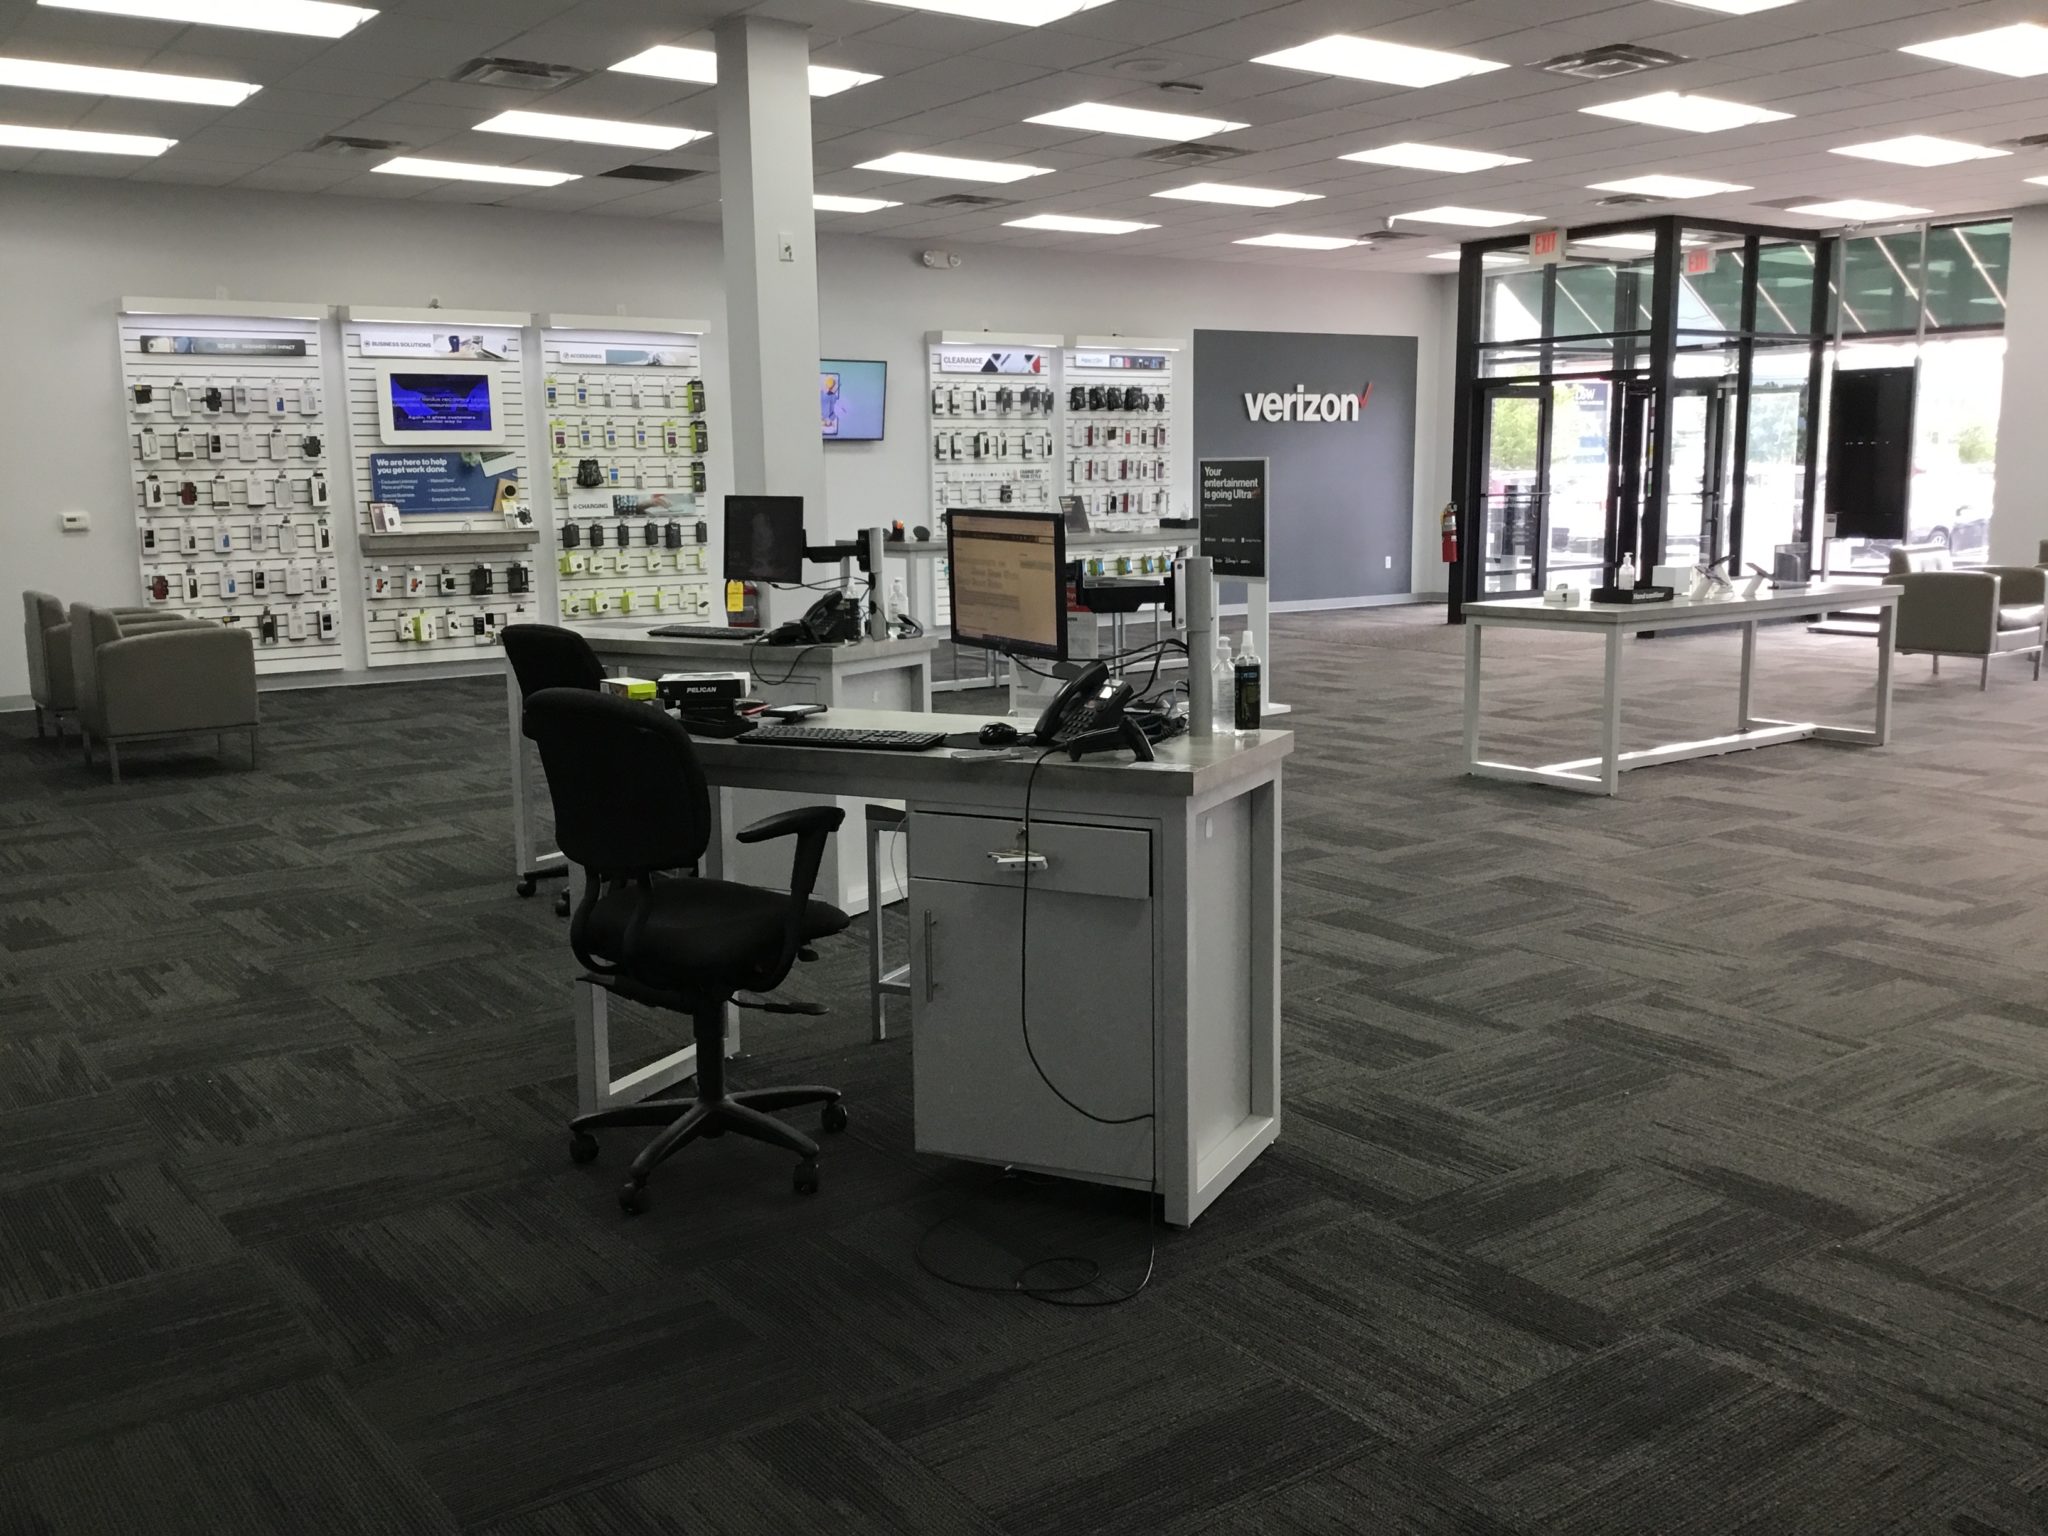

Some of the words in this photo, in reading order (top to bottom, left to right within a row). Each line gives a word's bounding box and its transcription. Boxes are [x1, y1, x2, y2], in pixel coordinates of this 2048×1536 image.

[1535, 232, 1557, 255] EXIT
[943, 356, 983, 365] CLEARANCE
[1244, 384, 1359, 422] verizon
[376, 458, 389, 466] We
[403, 458, 421, 466] here
[422, 458, 430, 466] to
[430, 457, 448, 467] help
[377, 467, 392, 475] you
[392, 466, 405, 475] get
[426, 465, 448, 473] done.
[1204, 466, 1222, 477] Your
[1204, 478, 1258, 488] entertainment
[1204, 489, 1211, 499] is
[1211, 489, 1233, 501] going
[1233, 488, 1252, 499] Ultra
